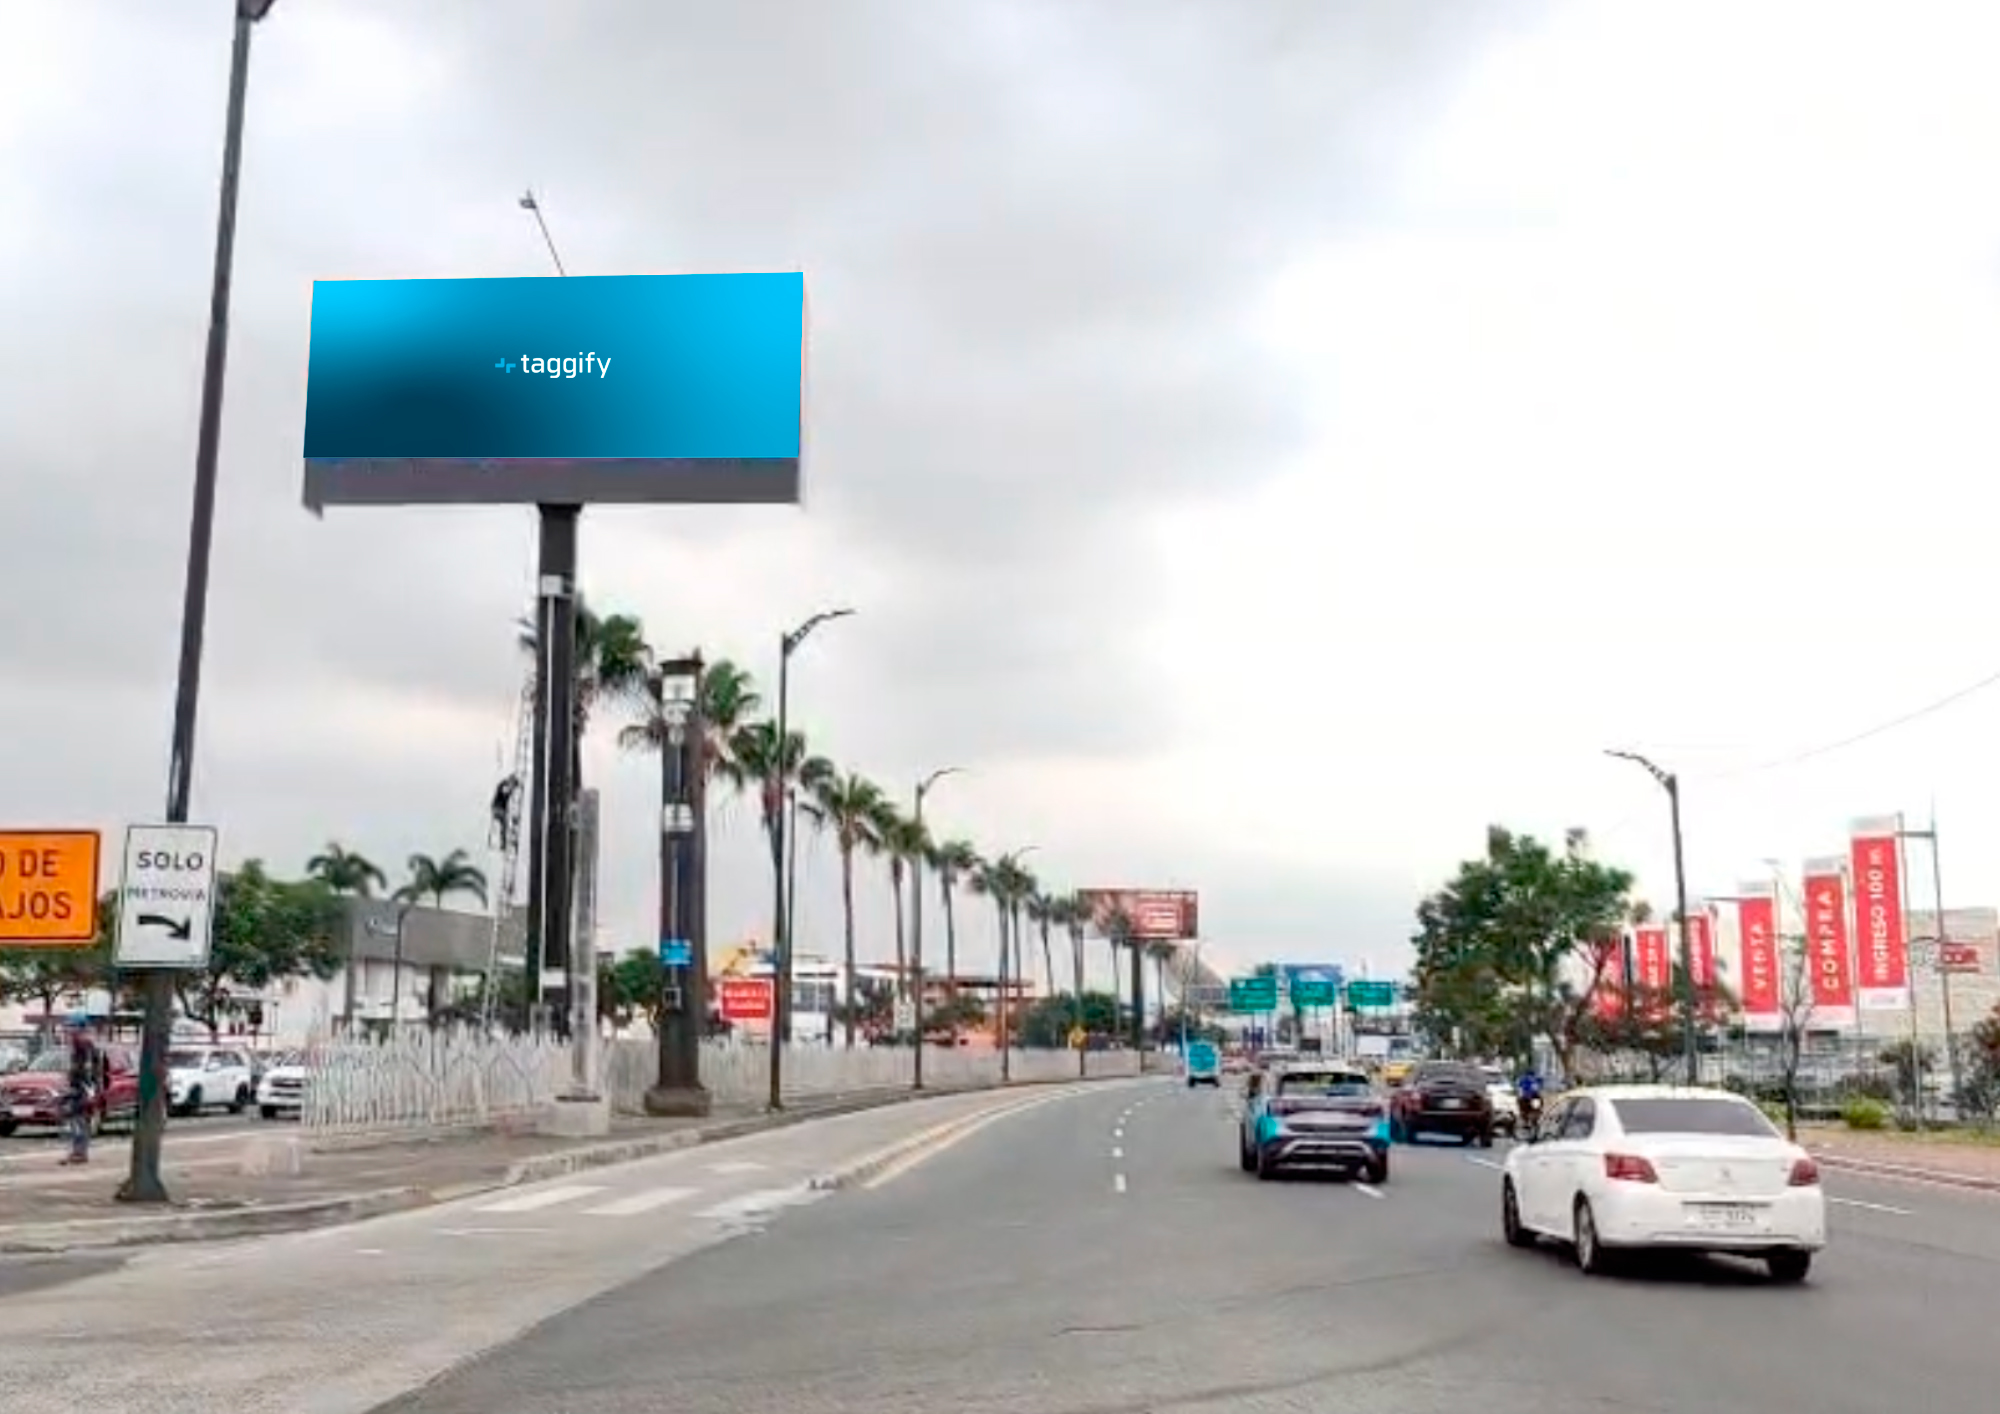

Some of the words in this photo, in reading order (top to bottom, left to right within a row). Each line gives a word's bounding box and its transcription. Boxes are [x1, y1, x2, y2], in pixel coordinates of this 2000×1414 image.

[521, 352, 611, 378] taggify
[19, 849, 59, 877] DE
[137, 852, 203, 870] SOLO
[1868, 869, 1884, 899] 100
[1817, 890, 1839, 990] COMPRA
[1870, 905, 1888, 981] INGRESO
[1749, 923, 1767, 990] VENTA
